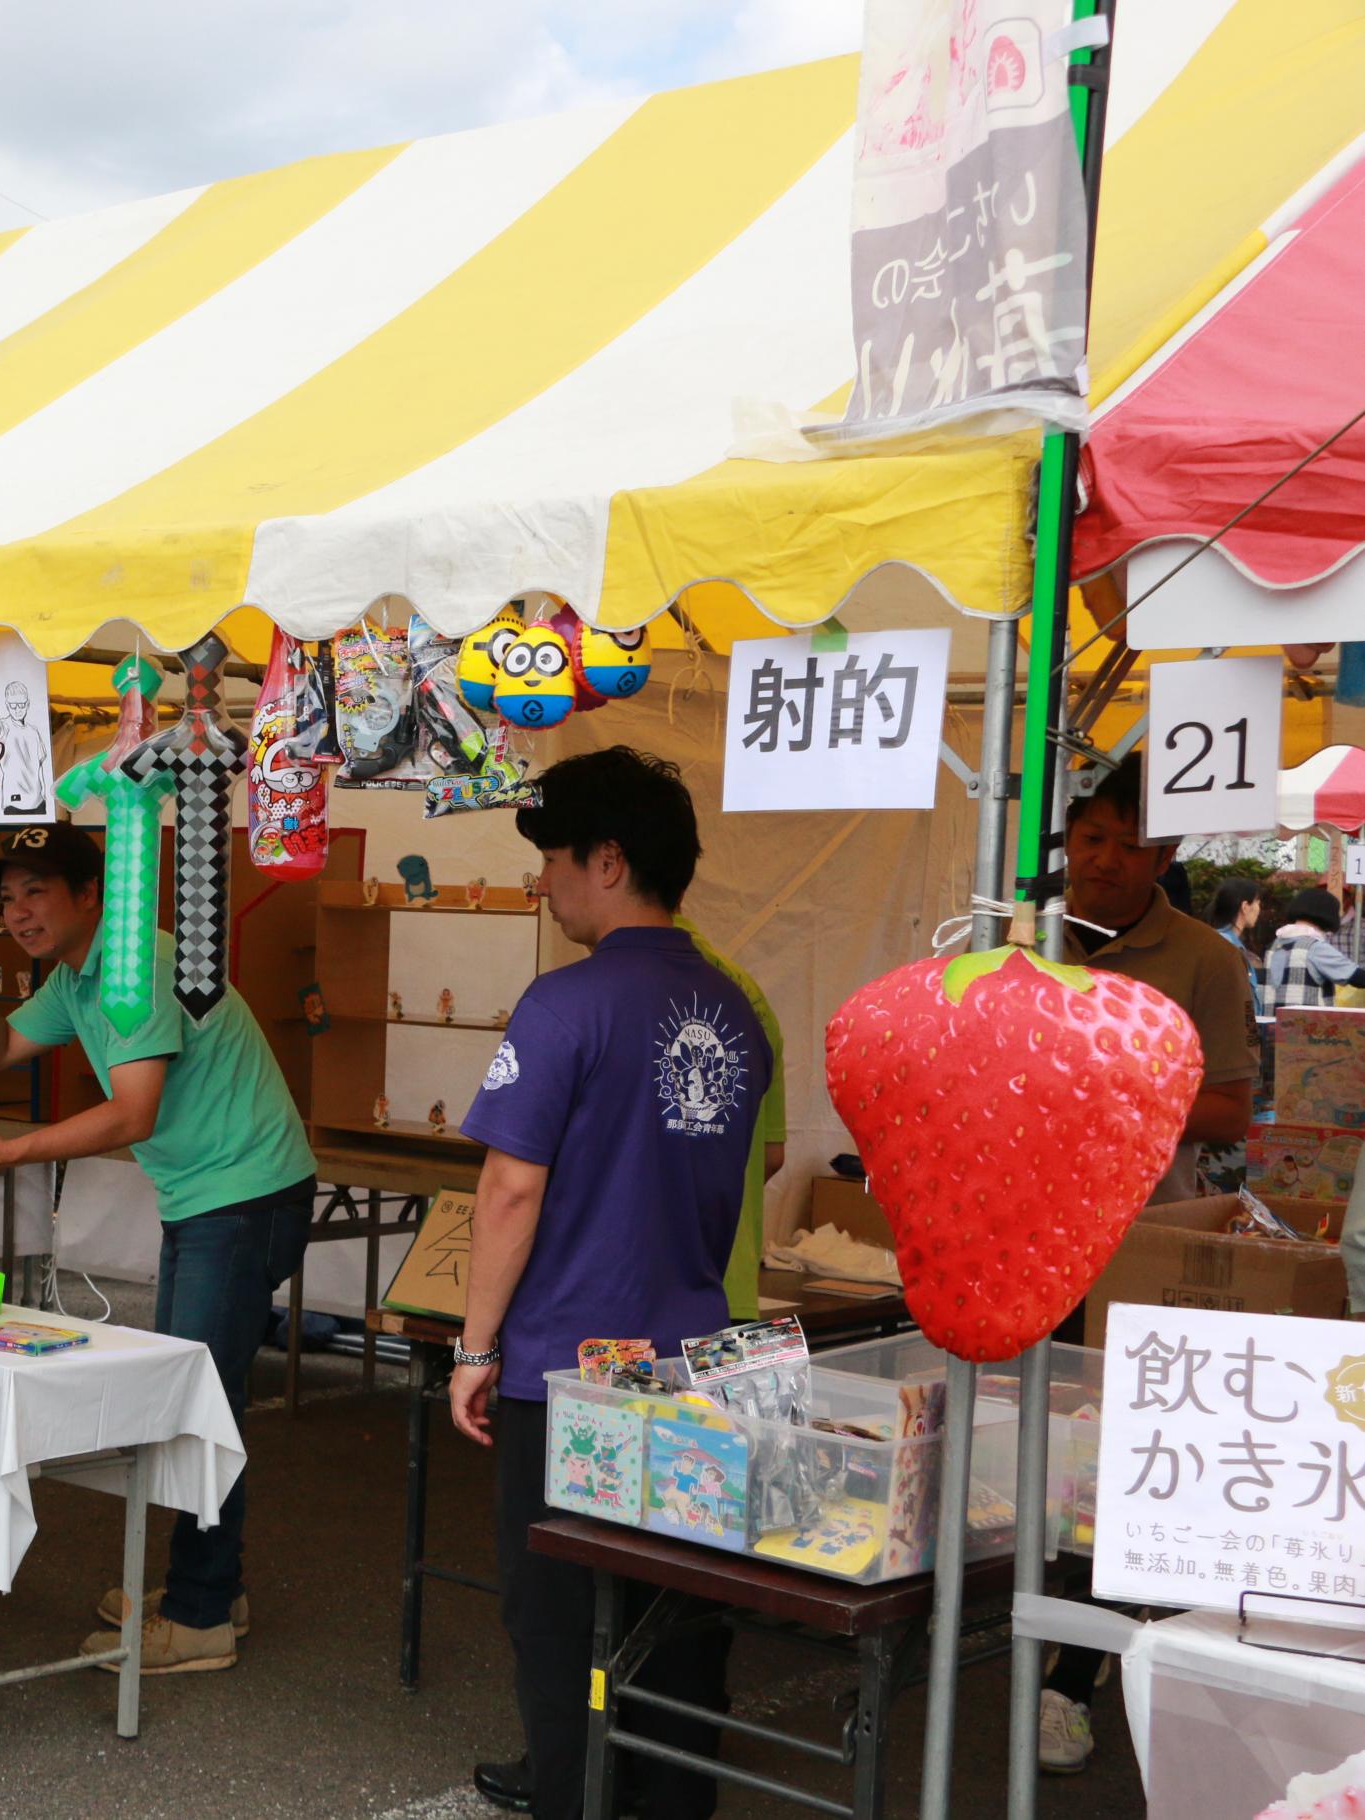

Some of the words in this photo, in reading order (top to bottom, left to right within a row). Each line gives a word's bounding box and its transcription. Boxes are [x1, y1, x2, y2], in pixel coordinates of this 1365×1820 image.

[741, 652, 919, 753] 射的
[443, 782, 482, 800] ZEUS
[1163, 717, 1255, 794] 21
[685, 1029, 711, 1041] NASU
[1124, 1330, 1317, 1423] 飲む
[1124, 1429, 1365, 1522] かき氷
[1123, 1549, 1365, 1599] 無添加。無着色。果肉
